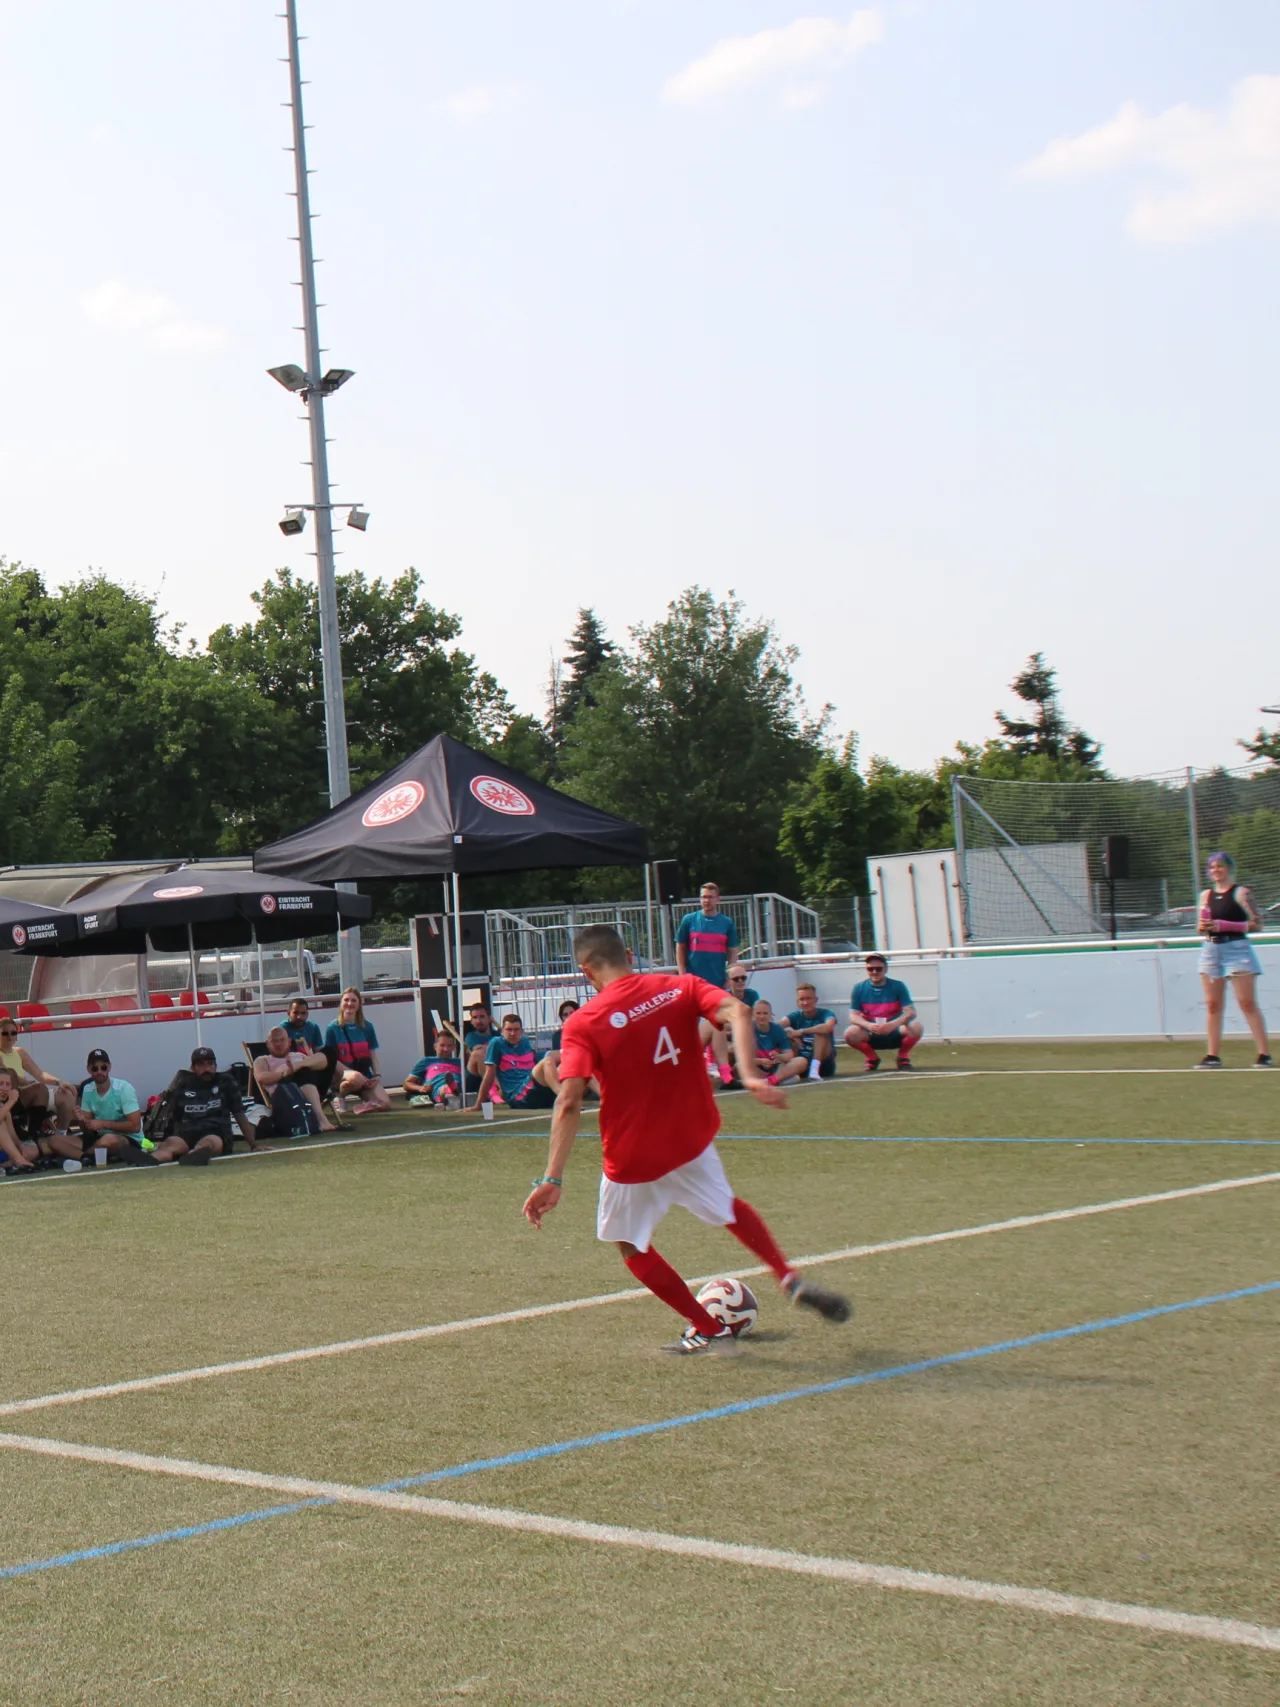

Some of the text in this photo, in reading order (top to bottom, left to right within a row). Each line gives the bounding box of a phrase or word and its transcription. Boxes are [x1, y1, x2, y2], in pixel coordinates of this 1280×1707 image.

[28, 930, 58, 940] FRANKFURT
[628, 988, 683, 1018] ASKLEPIOS
[653, 1026, 681, 1066] 4
